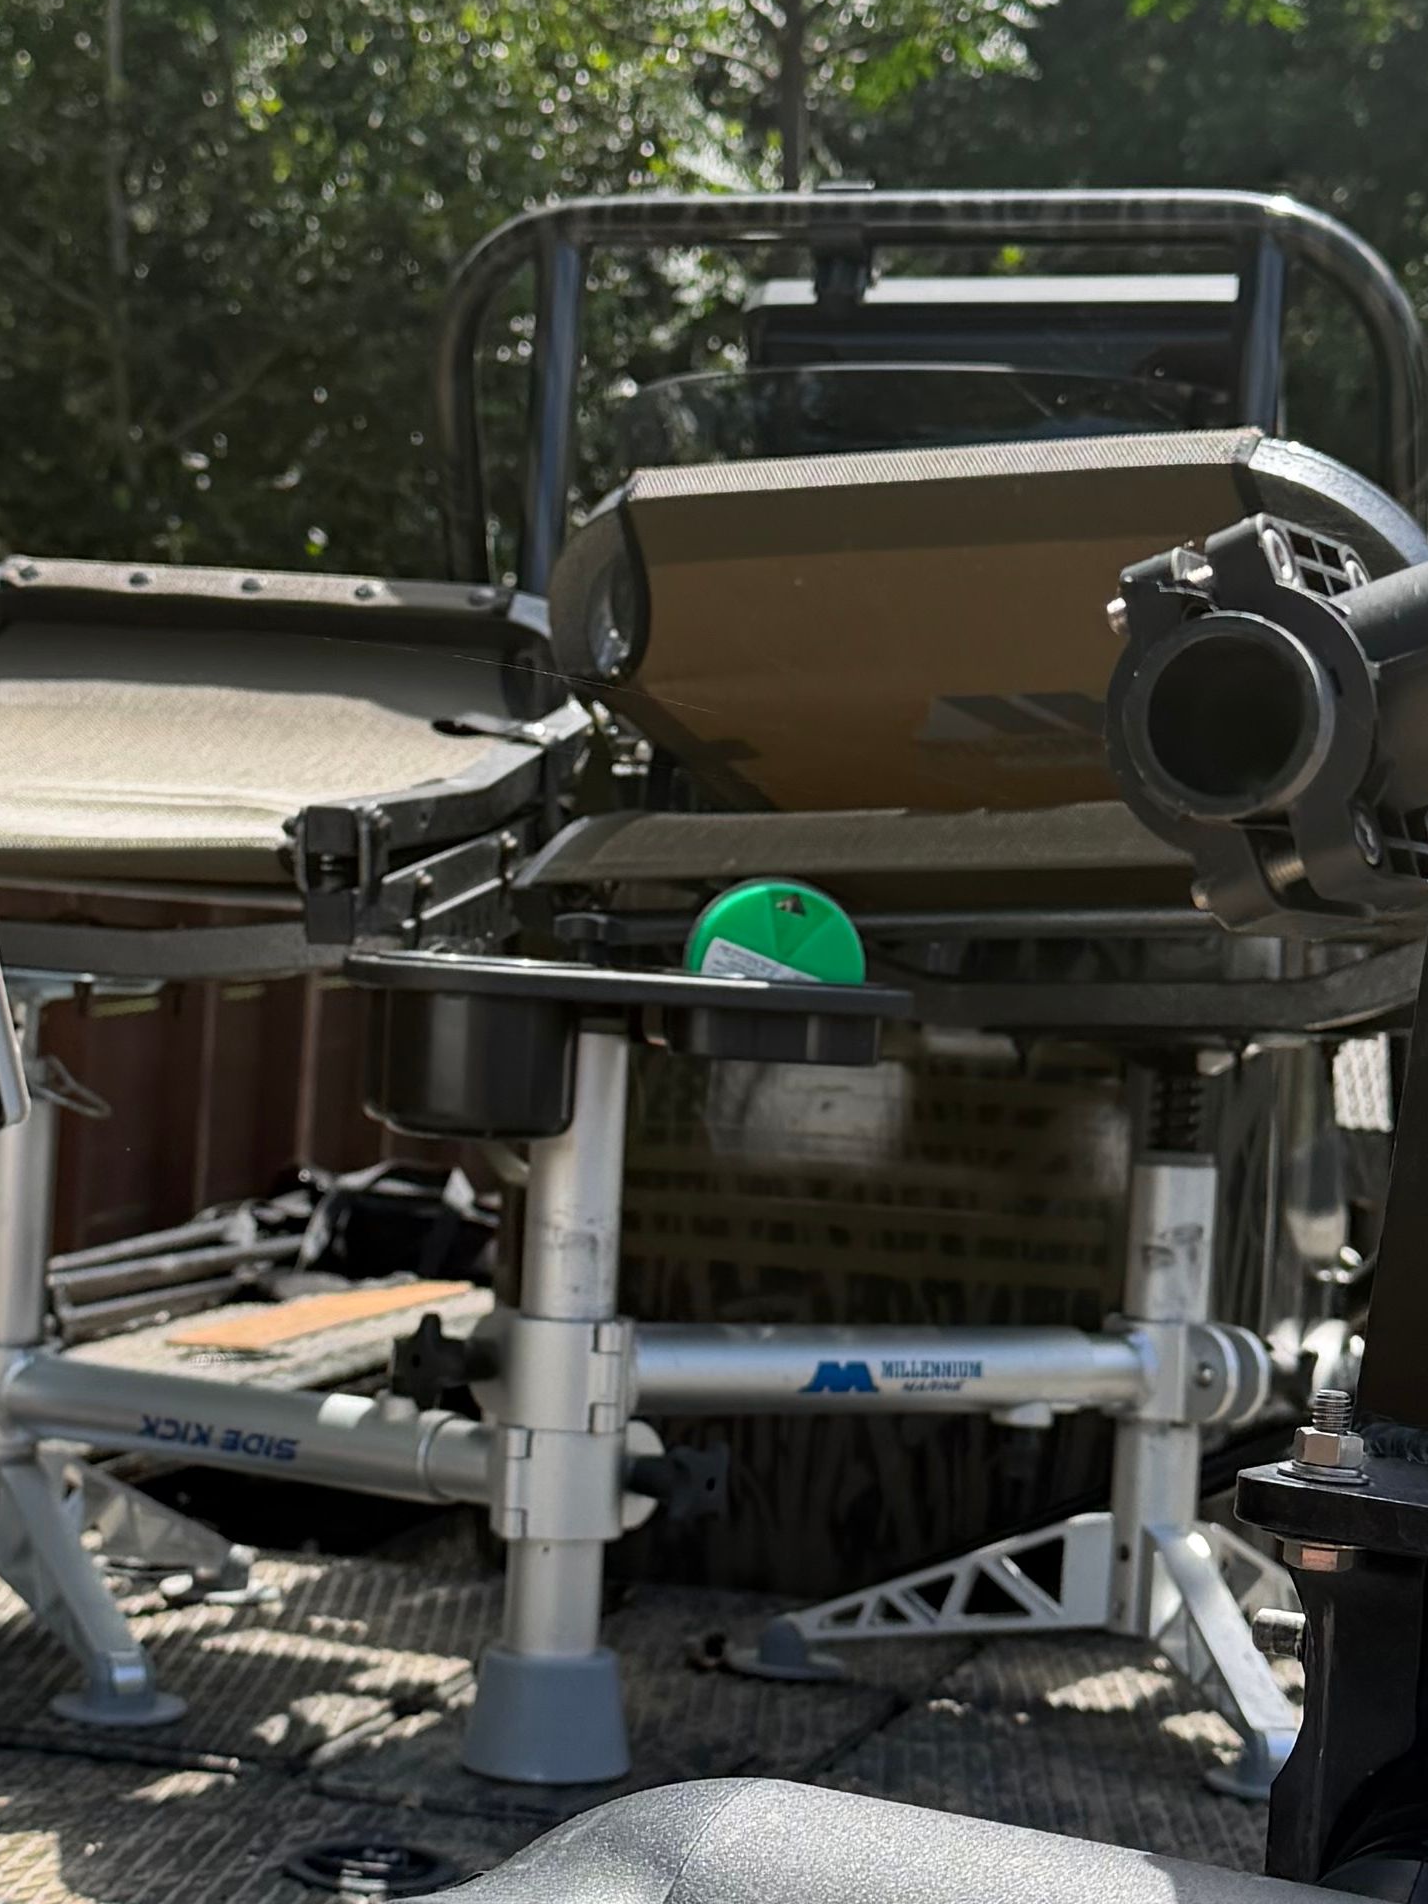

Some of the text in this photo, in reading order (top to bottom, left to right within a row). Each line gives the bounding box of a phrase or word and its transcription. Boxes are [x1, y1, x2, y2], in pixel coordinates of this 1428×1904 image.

[881, 1360, 983, 1378] MILLENNIUM
[139, 1413, 300, 1461] SIDE KICK
